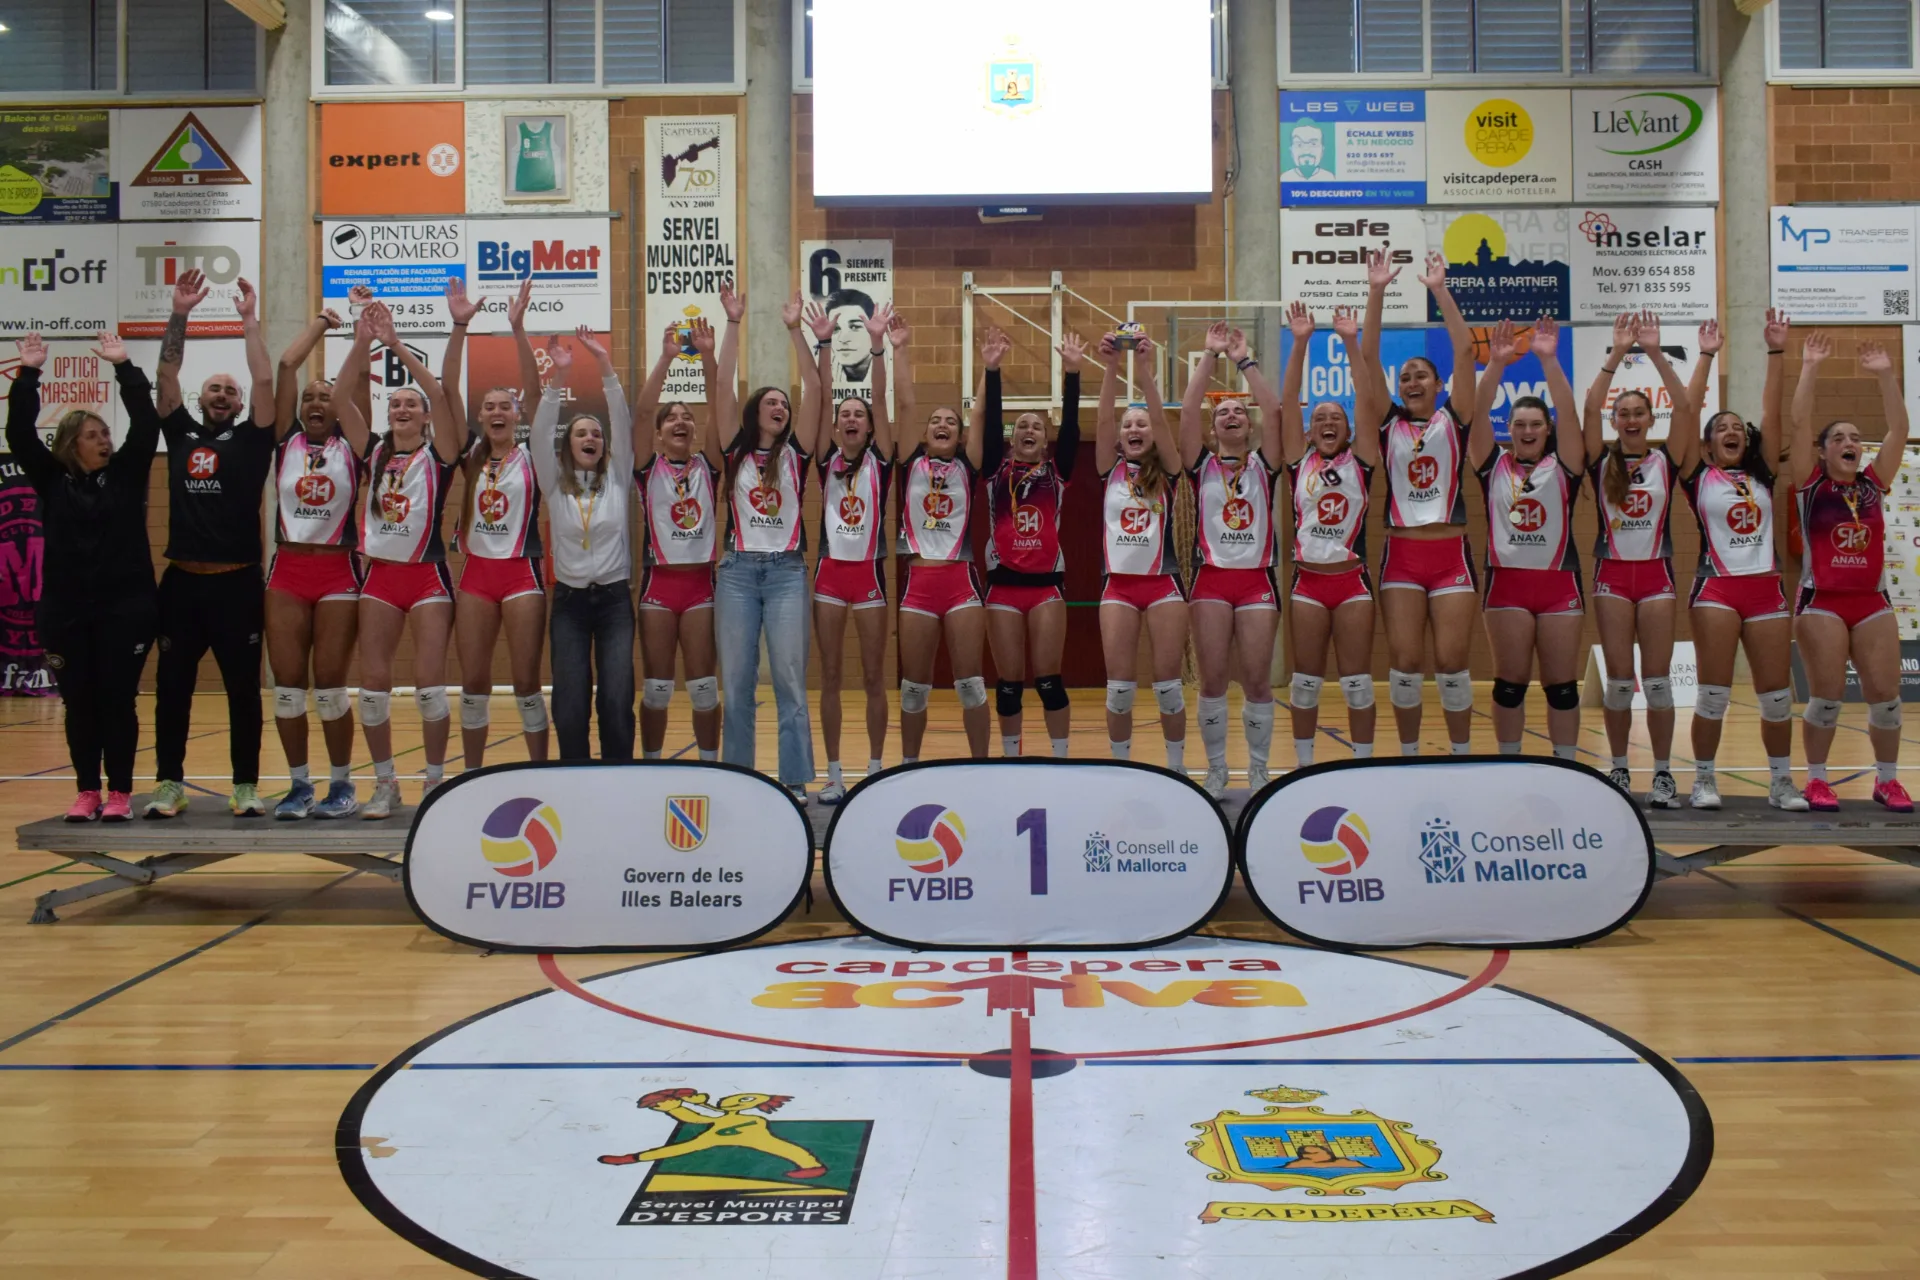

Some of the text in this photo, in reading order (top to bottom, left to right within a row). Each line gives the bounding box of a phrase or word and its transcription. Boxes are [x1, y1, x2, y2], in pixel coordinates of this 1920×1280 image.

[1290, 102, 1415, 113] LBS WEB
[1476, 112, 1518, 128] visit
[1386, 130, 1415, 138] WEBS
[1475, 129, 1530, 141] CAPDE
[1371, 139, 1414, 147] NEGOCIO
[1475, 141, 1517, 154] PERA
[329, 151, 421, 170] expert
[1628, 159, 1663, 170] CASH
[1443, 172, 1557, 186] visitcapdepera.com
[1291, 190, 1309, 198] 10%
[1309, 190, 1363, 198] DESCUENTO
[1507, 187, 1557, 195] HOTELERA
[667, 200, 715, 208] ANY 2000
[371, 224, 458, 240] PINTURAS
[663, 217, 719, 241] SERVEI
[1315, 218, 1390, 237] cafe
[1838, 228, 1909, 236] TRANSFERS
[1596, 225, 1706, 248] inselar
[371, 241, 459, 260] ROMERO
[647, 243, 734, 268] MUNICIPAL
[1596, 249, 1648, 257] INSTALACIONES
[478, 240, 601, 280] BigMat
[846, 258, 885, 269] SIEMPRE
[400, 267, 410, 275] DE
[411, 267, 446, 275] FACHADAS
[1592, 265, 1696, 277] Mov. 639 654 858
[647, 270, 735, 294] D'ESPORTS
[844, 272, 887, 283] PRESENTE
[1443, 276, 1558, 288] ERERA & PARTNER
[1596, 282, 1691, 293] Tel. 971 835 595
[408, 304, 434, 315] 435
[1481, 308, 1503, 316] 607
[41, 381, 110, 404] MASSANET
[1408, 486, 1441, 500] ANAYA
[293, 506, 332, 518] ANAYA
[750, 515, 784, 526] ANAYA
[1620, 519, 1653, 528] ANAYA
[380, 523, 410, 534] ANAYA
[475, 521, 509, 533] ANAYA
[671, 527, 704, 539] ANAYA
[836, 523, 865, 534] ANAYA
[1310, 526, 1344, 537] ANAYA
[1013, 538, 1043, 548] ANAYA
[1116, 533, 1150, 544] ANAYA
[1220, 532, 1255, 542] ANAYA
[1510, 533, 1547, 544] ANAYA
[1729, 534, 1764, 546] ANAYA
[1831, 555, 1868, 565] ANAYA
[1470, 826, 1604, 854] Consell de
[1015, 807, 1049, 896] 1
[1116, 838, 1199, 855] Consell de
[1116, 857, 1187, 874] Mallorca
[1474, 857, 1588, 883] Mallorca
[623, 867, 744, 885] Govern de les
[888, 876, 975, 902] FVBIB
[1298, 877, 1385, 905] FVBIB
[465, 881, 566, 910] FVBIB
[621, 889, 743, 908] Illes Balears
[775, 955, 1283, 977] capdepera
[639, 1199, 844, 1211] Servei Municipal
[1221, 1203, 1474, 1219] CAPDEPERA
[629, 1210, 842, 1223] D'ESPORTS
